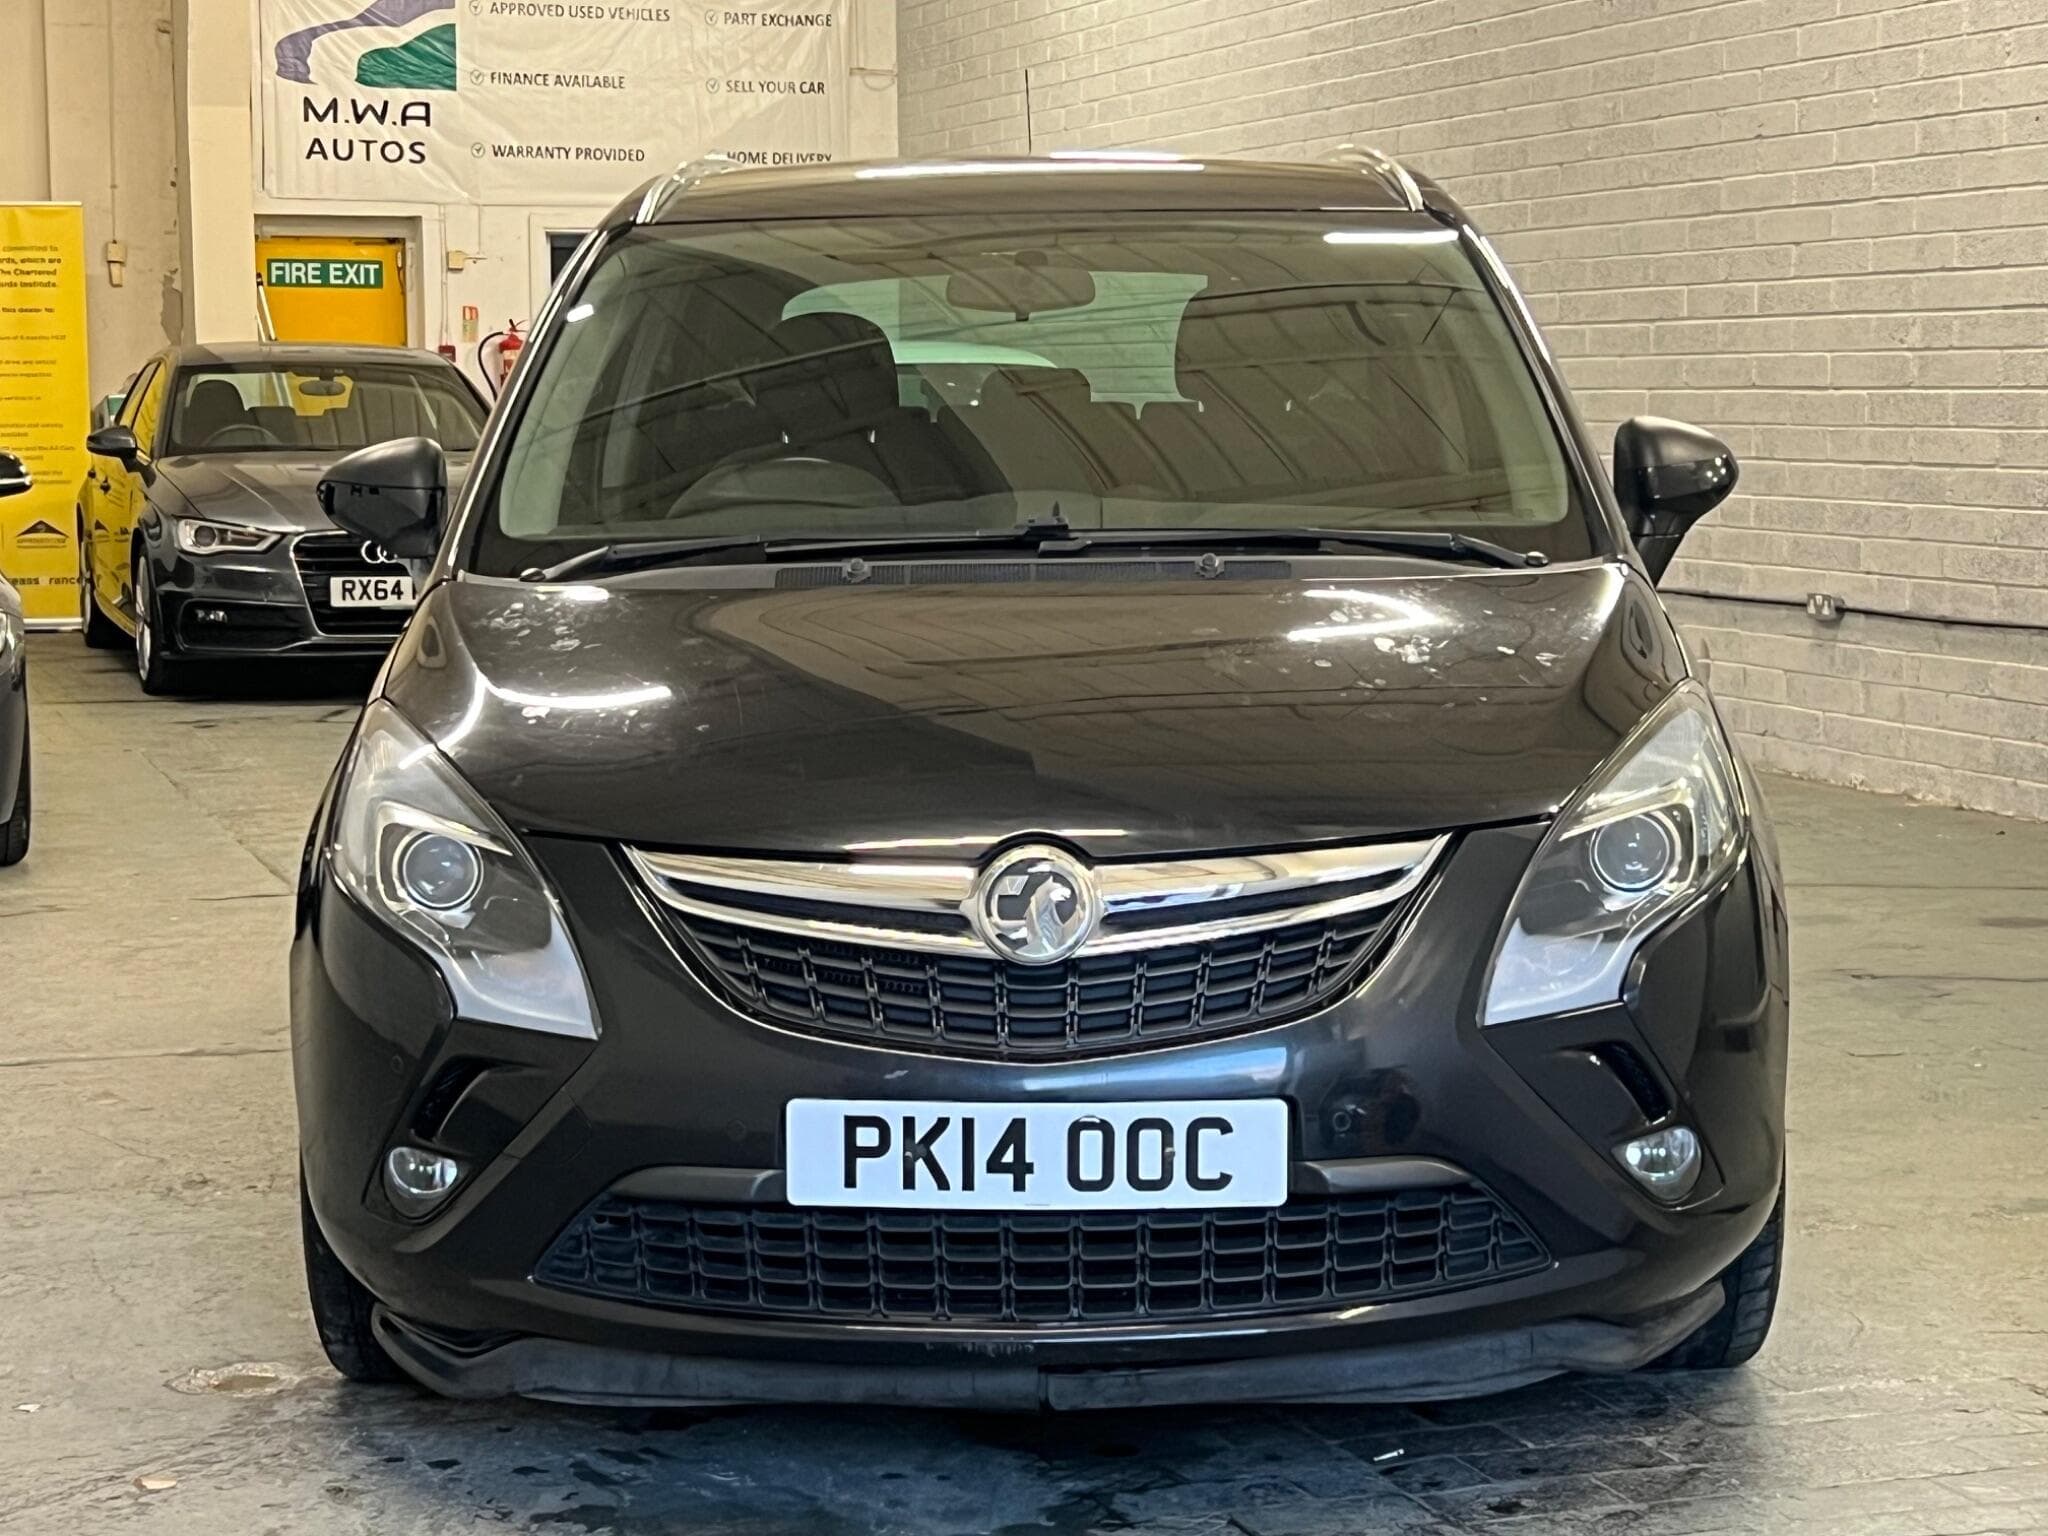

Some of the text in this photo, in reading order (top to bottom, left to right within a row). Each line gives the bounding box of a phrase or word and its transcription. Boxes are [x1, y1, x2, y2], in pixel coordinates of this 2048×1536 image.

[490, 2, 670, 21] APPROVED USED VEHICLES
[724, 12, 832, 27] PART EXCHANGE
[490, 72, 625, 89] FINANCE AVAILABLE
[726, 80, 825, 94] SELL YOUR CAR
[303, 96, 431, 127] M.W.A
[305, 138, 426, 164] AUTOS
[492, 144, 645, 162] WARRANTY PROVIDED
[772, 152, 832, 165] DELIVERY
[270, 262, 379, 285] FIRE EXIT
[342, 579, 403, 601] RX64
[844, 1115, 1234, 1192] PK14 OOC
